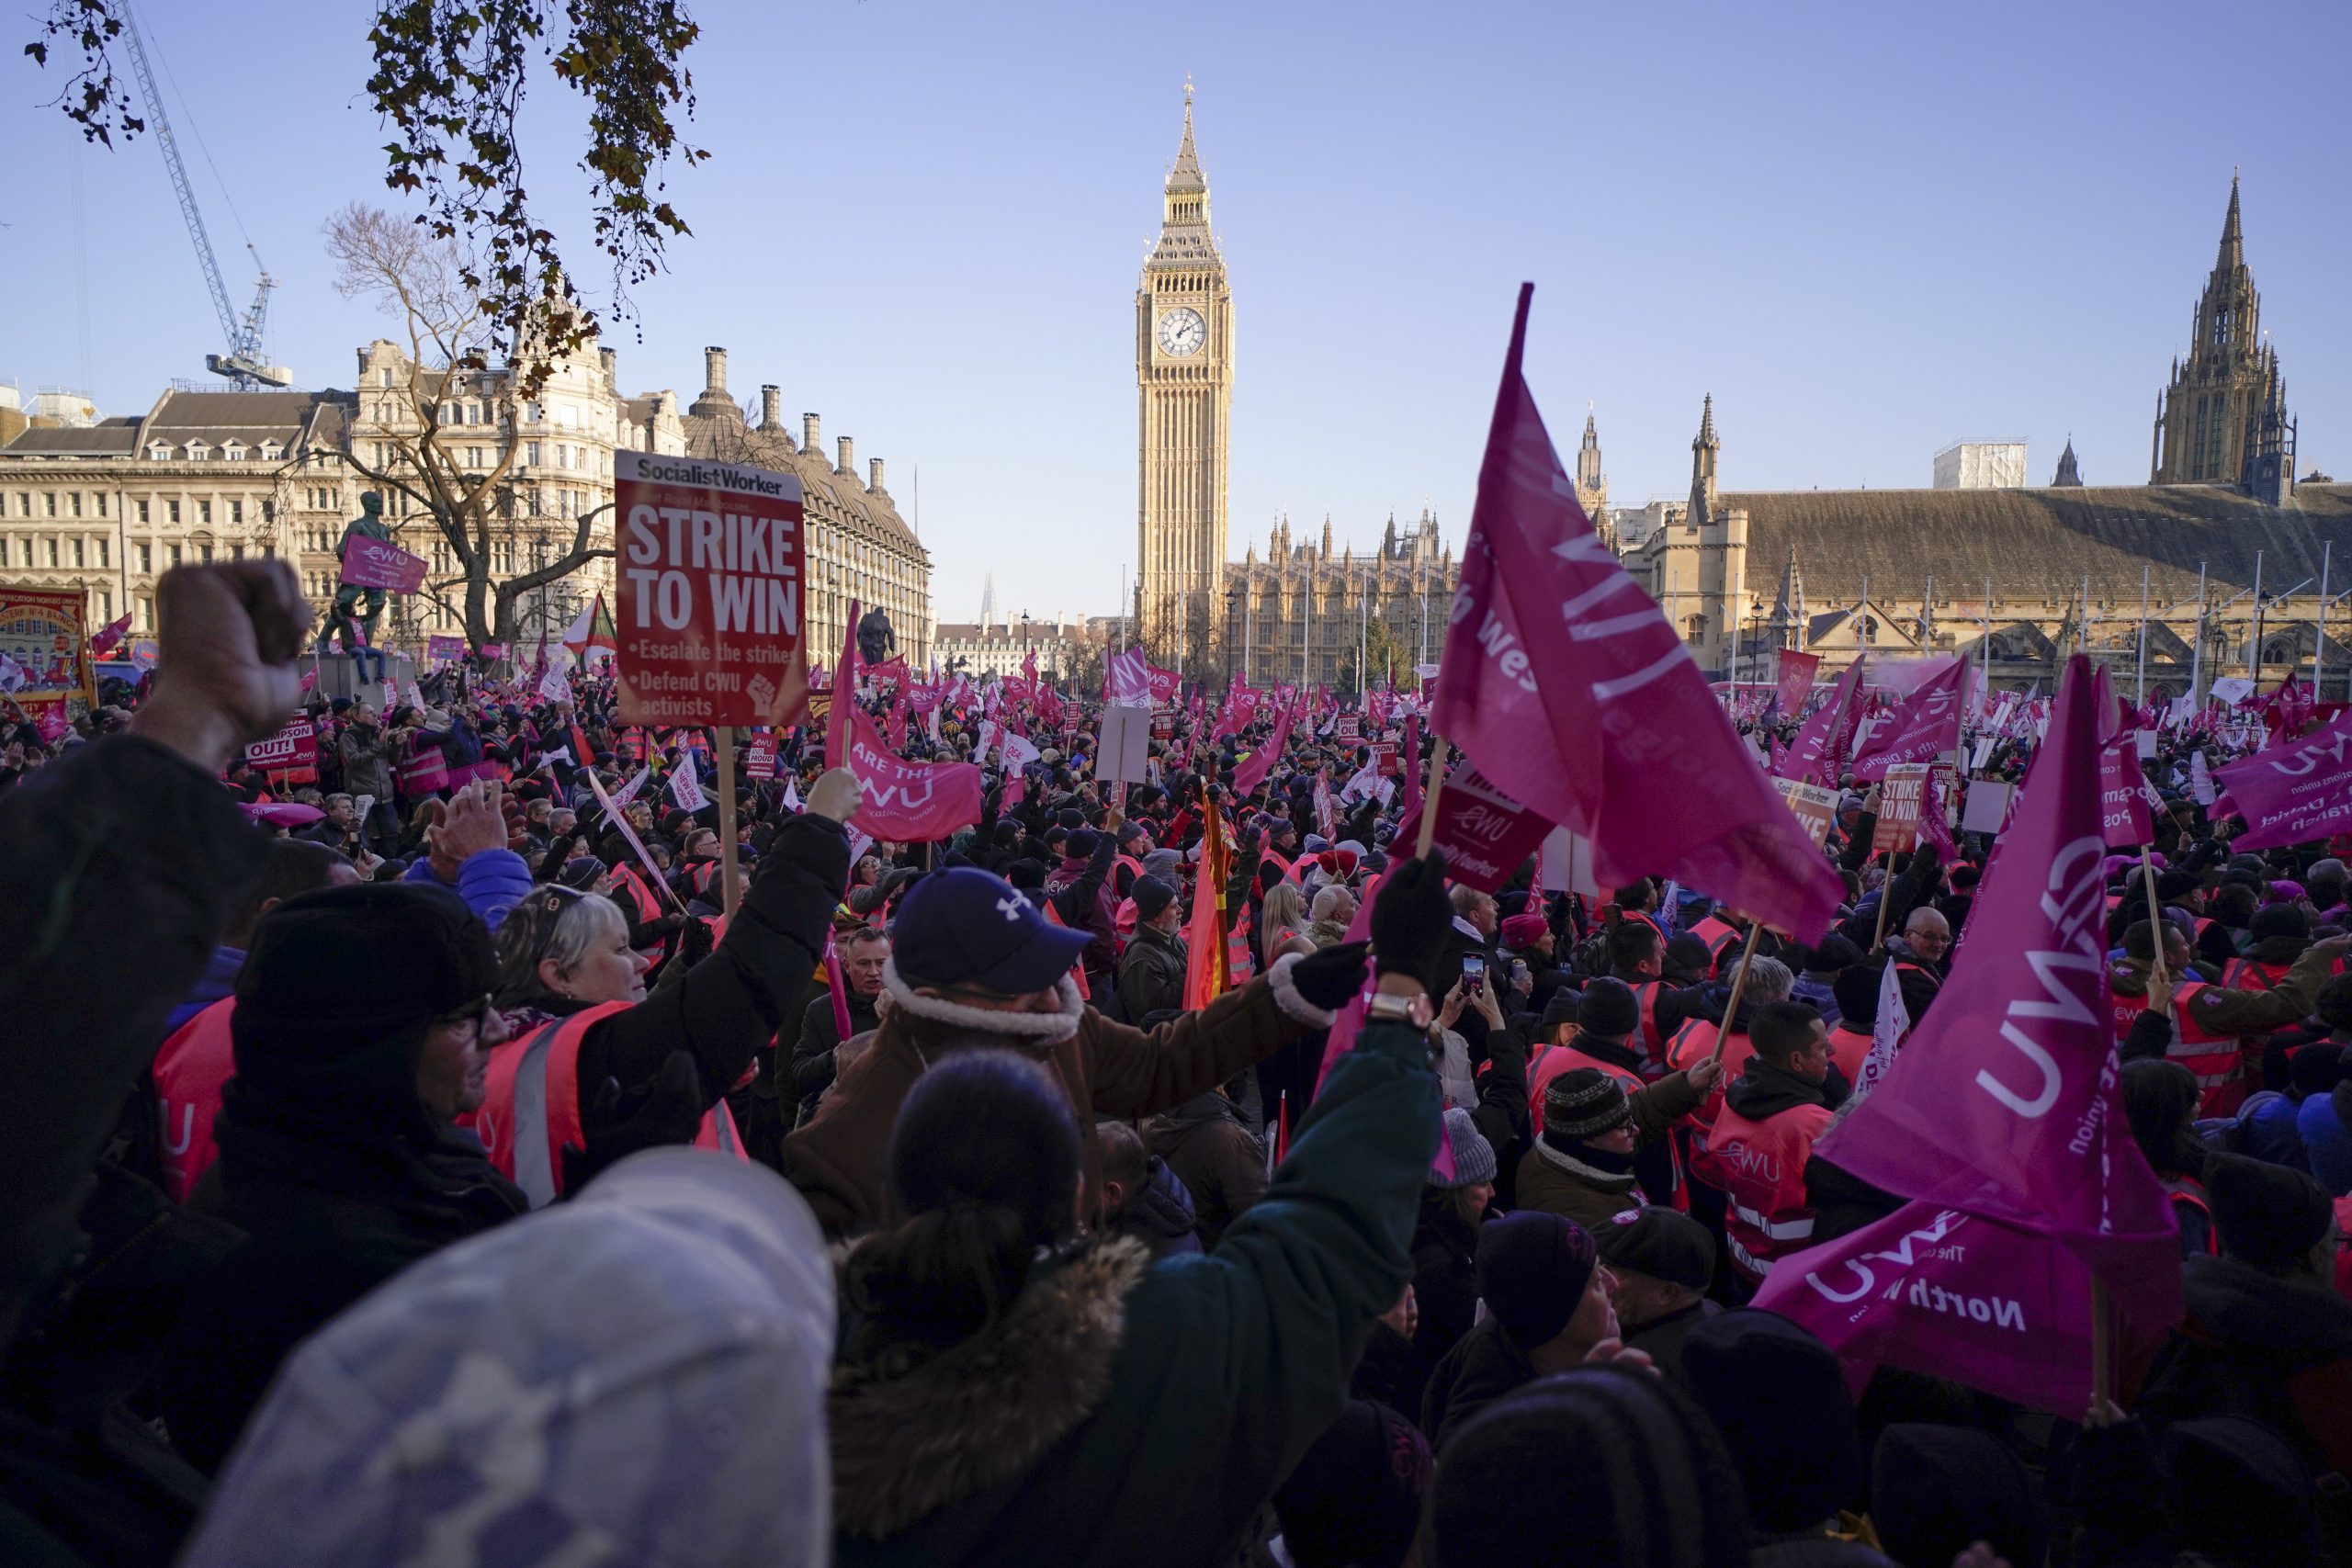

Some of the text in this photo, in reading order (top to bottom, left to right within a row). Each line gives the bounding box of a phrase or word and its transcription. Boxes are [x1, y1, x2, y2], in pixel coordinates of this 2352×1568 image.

[628, 504, 797, 577] STRIKE
[362, 546, 408, 566] CWU
[626, 568, 797, 636] TO WIN
[47, 610, 76, 630] BRANCH
[639, 637, 798, 665] Escalate the strikes
[640, 671, 741, 693] Defend CWU
[641, 695, 713, 716] activists
[250, 739, 290, 757] OUT!
[293, 750, 315, 760] CWU
[852, 741, 935, 780] ARE THE
[686, 788, 699, 807] DEAL
[1883, 779, 1923, 800] STRIKE
[1880, 799, 1920, 821] TO WIN
[1453, 805, 1513, 841] CWU
[1716, 1141, 1781, 1183] CWU
